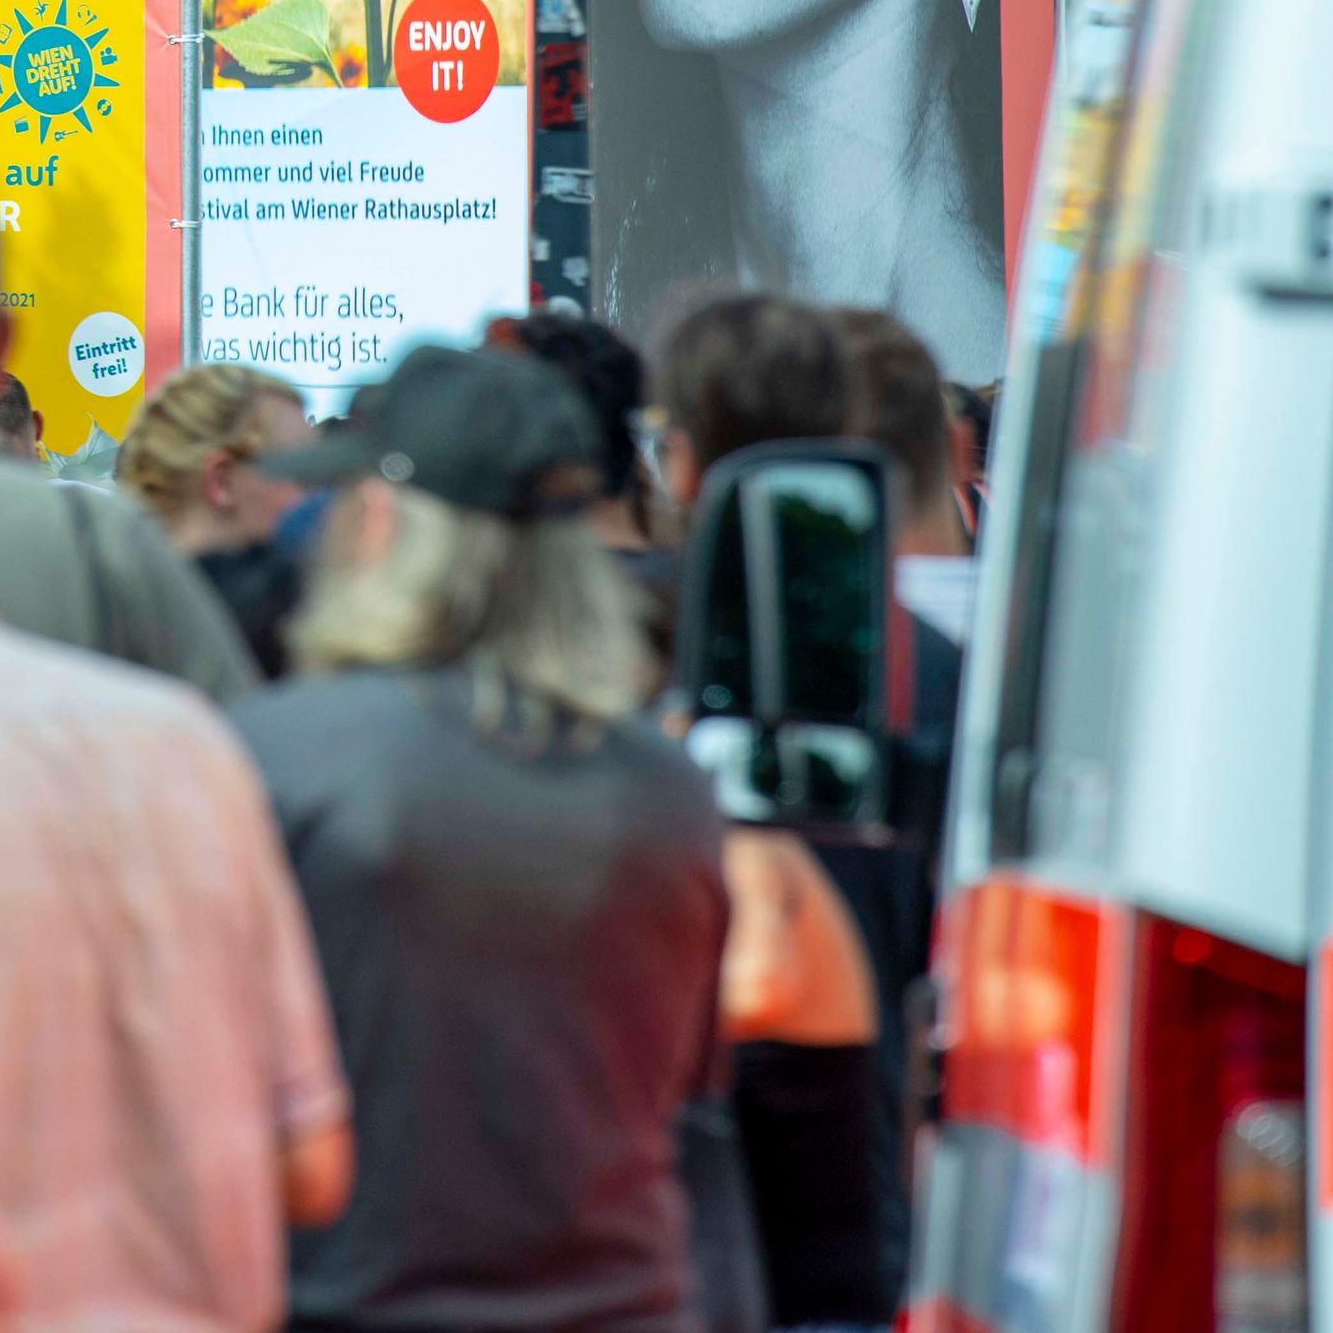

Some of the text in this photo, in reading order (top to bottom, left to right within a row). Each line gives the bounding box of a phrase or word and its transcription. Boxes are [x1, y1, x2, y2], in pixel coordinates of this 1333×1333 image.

[408, 20, 486, 53] ENJOY
[27, 44, 73, 68] WIEN
[26, 58, 81, 84] DREHT
[431, 60, 465, 92] IT!
[39, 76, 77, 97] AUF!
[212, 123, 323, 146] Ihnen einen
[5, 155, 59, 186] auf
[278, 160, 424, 182] und viel Freude
[256, 197, 497, 224] am Wiener Rathausplatz!
[0, 292, 35, 307] 2021
[224, 286, 284, 318] Bank
[295, 286, 329, 317] für
[338, 287, 404, 323] alles,
[75, 336, 137, 361] Eintritt
[249, 331, 388, 371] wichtig ist.
[92, 358, 127, 379] frei!
